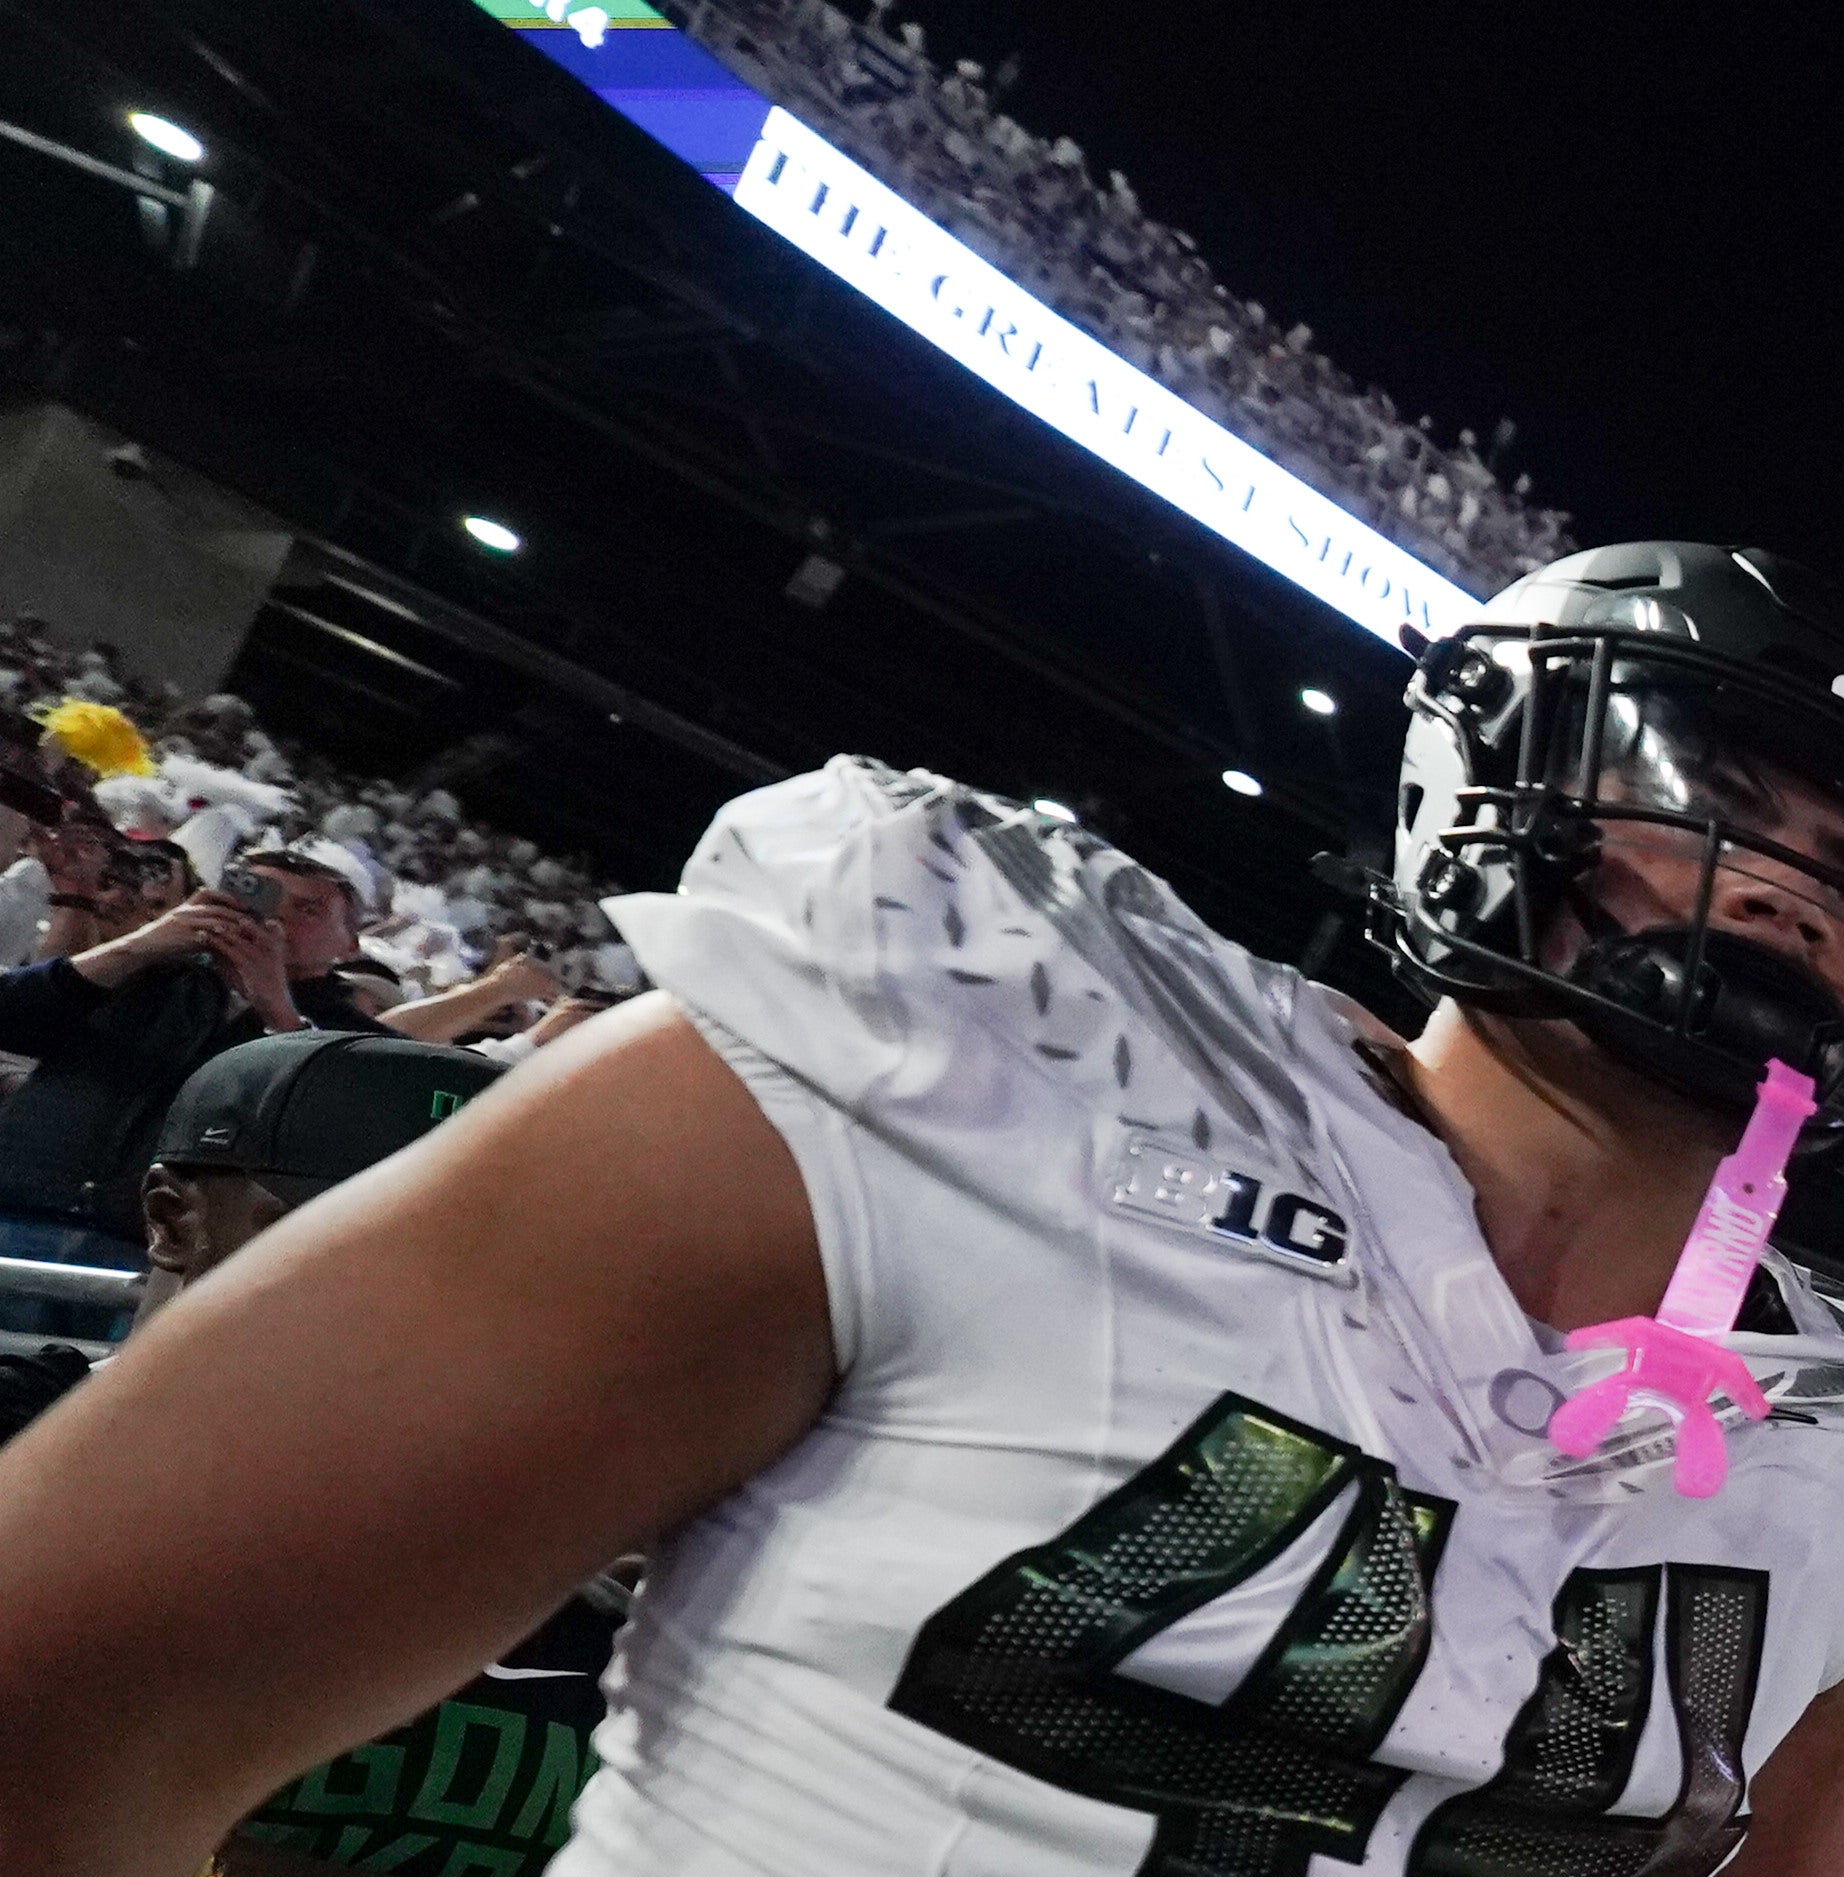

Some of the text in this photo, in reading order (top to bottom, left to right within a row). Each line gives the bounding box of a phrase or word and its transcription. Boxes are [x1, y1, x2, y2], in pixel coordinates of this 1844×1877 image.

[763, 150, 1436, 630] THE GREATEST SHOW
